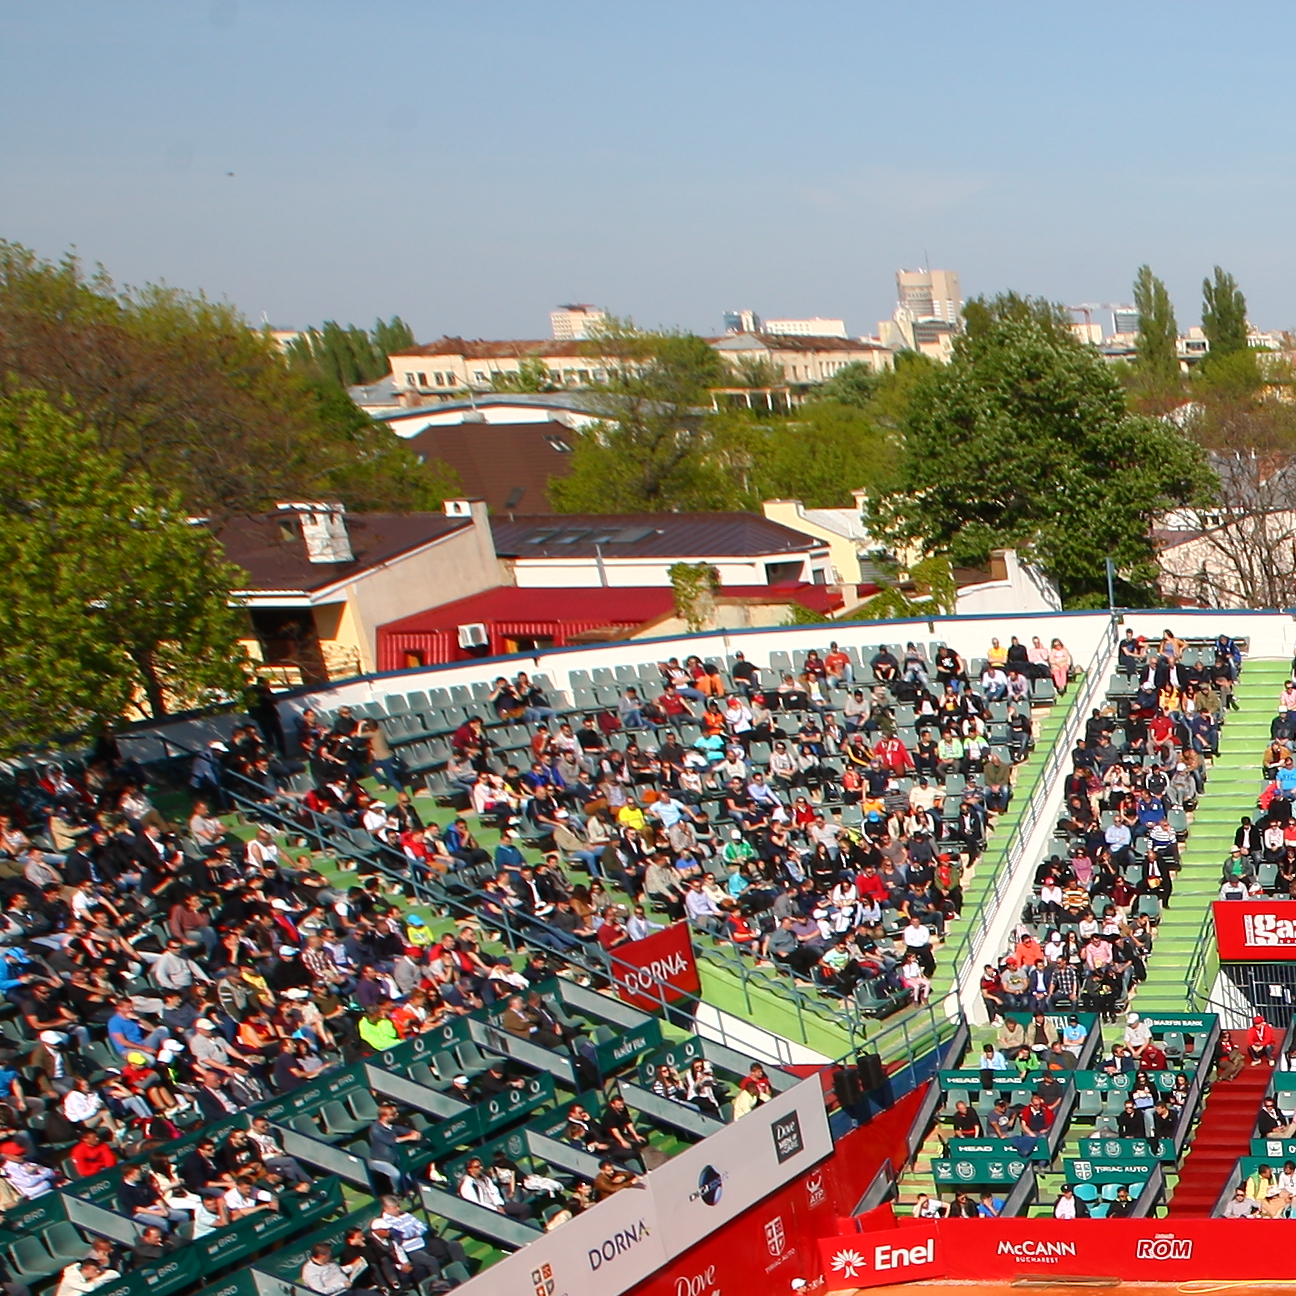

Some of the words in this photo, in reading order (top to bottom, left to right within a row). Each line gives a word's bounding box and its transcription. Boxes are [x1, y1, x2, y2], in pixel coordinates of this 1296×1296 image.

[624, 953, 688, 995] DORNA
[588, 1220, 651, 1271] DORNA
[874, 1238, 935, 1271] Enel
[997, 1240, 1076, 1256] McCANN
[1136, 1239, 1192, 1260] ROM
